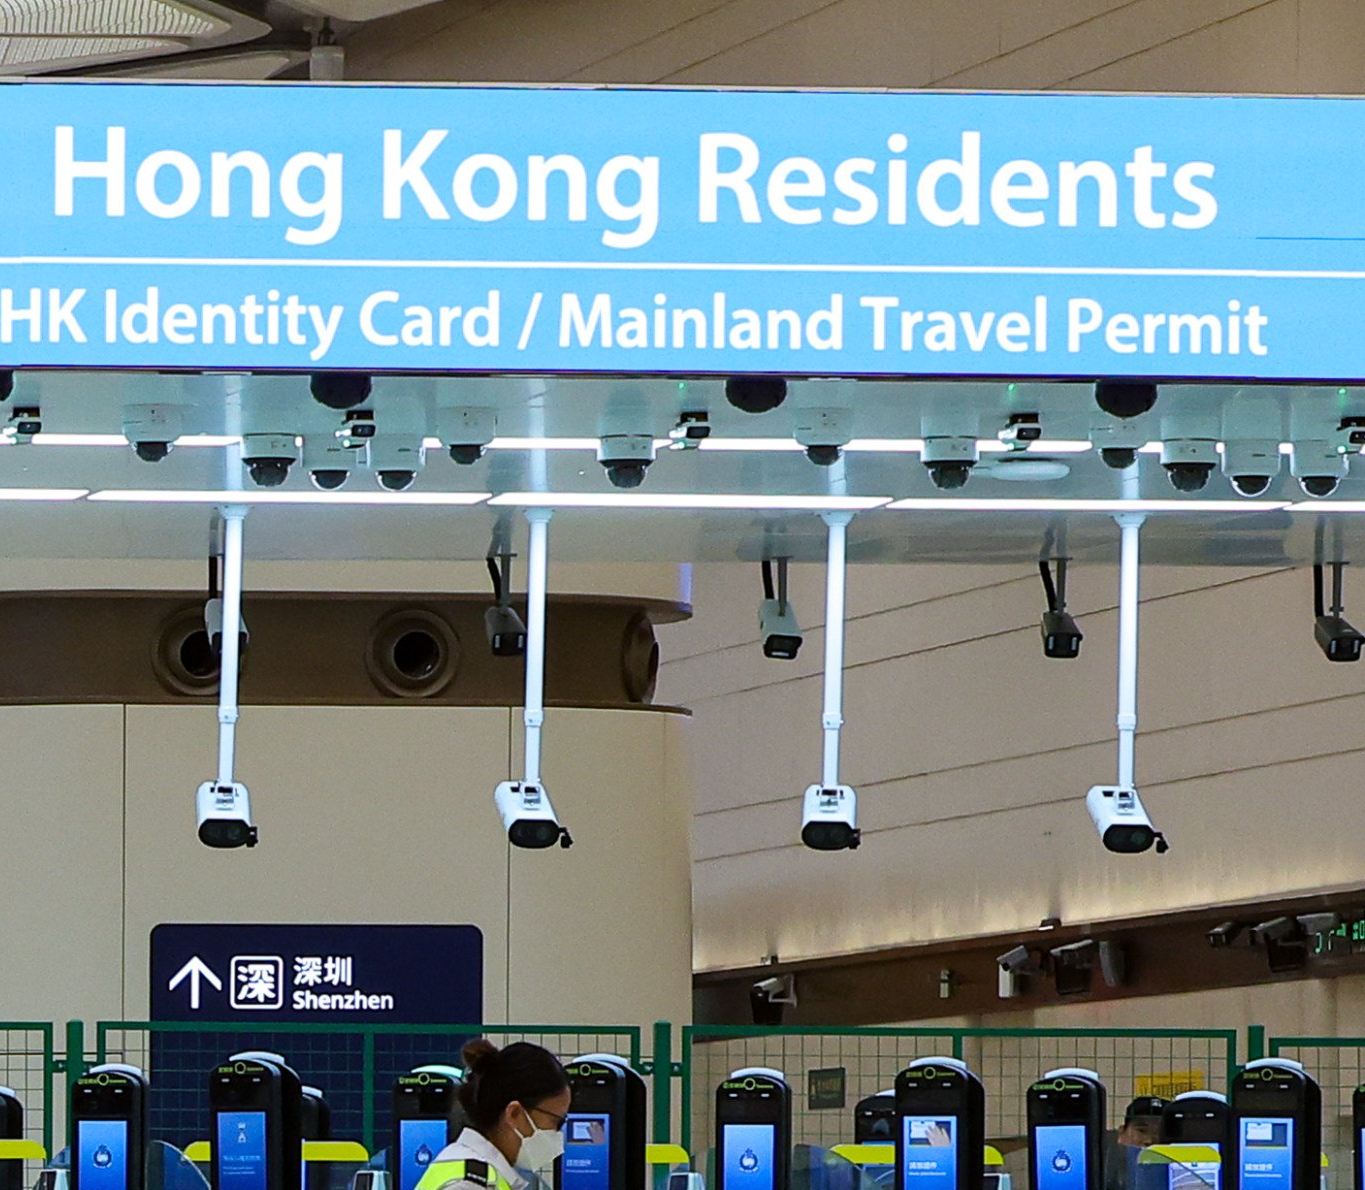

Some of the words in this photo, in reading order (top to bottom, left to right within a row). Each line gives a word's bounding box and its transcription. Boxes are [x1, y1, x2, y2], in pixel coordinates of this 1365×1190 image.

[54, 125, 343, 245] Hong
[383, 129, 659, 249] Kong
[699, 131, 1218, 229] Residents
[0, 287, 87, 343] HK
[105, 286, 343, 361] Identity
[359, 290, 500, 347] Card
[559, 292, 843, 350] Mainland
[860, 295, 1047, 352] Travel
[1068, 298, 1268, 356] Permit
[237, 963, 277, 1003] 深
[293, 956, 353, 987] 深圳
[292, 989, 395, 1010] Shenzhen
